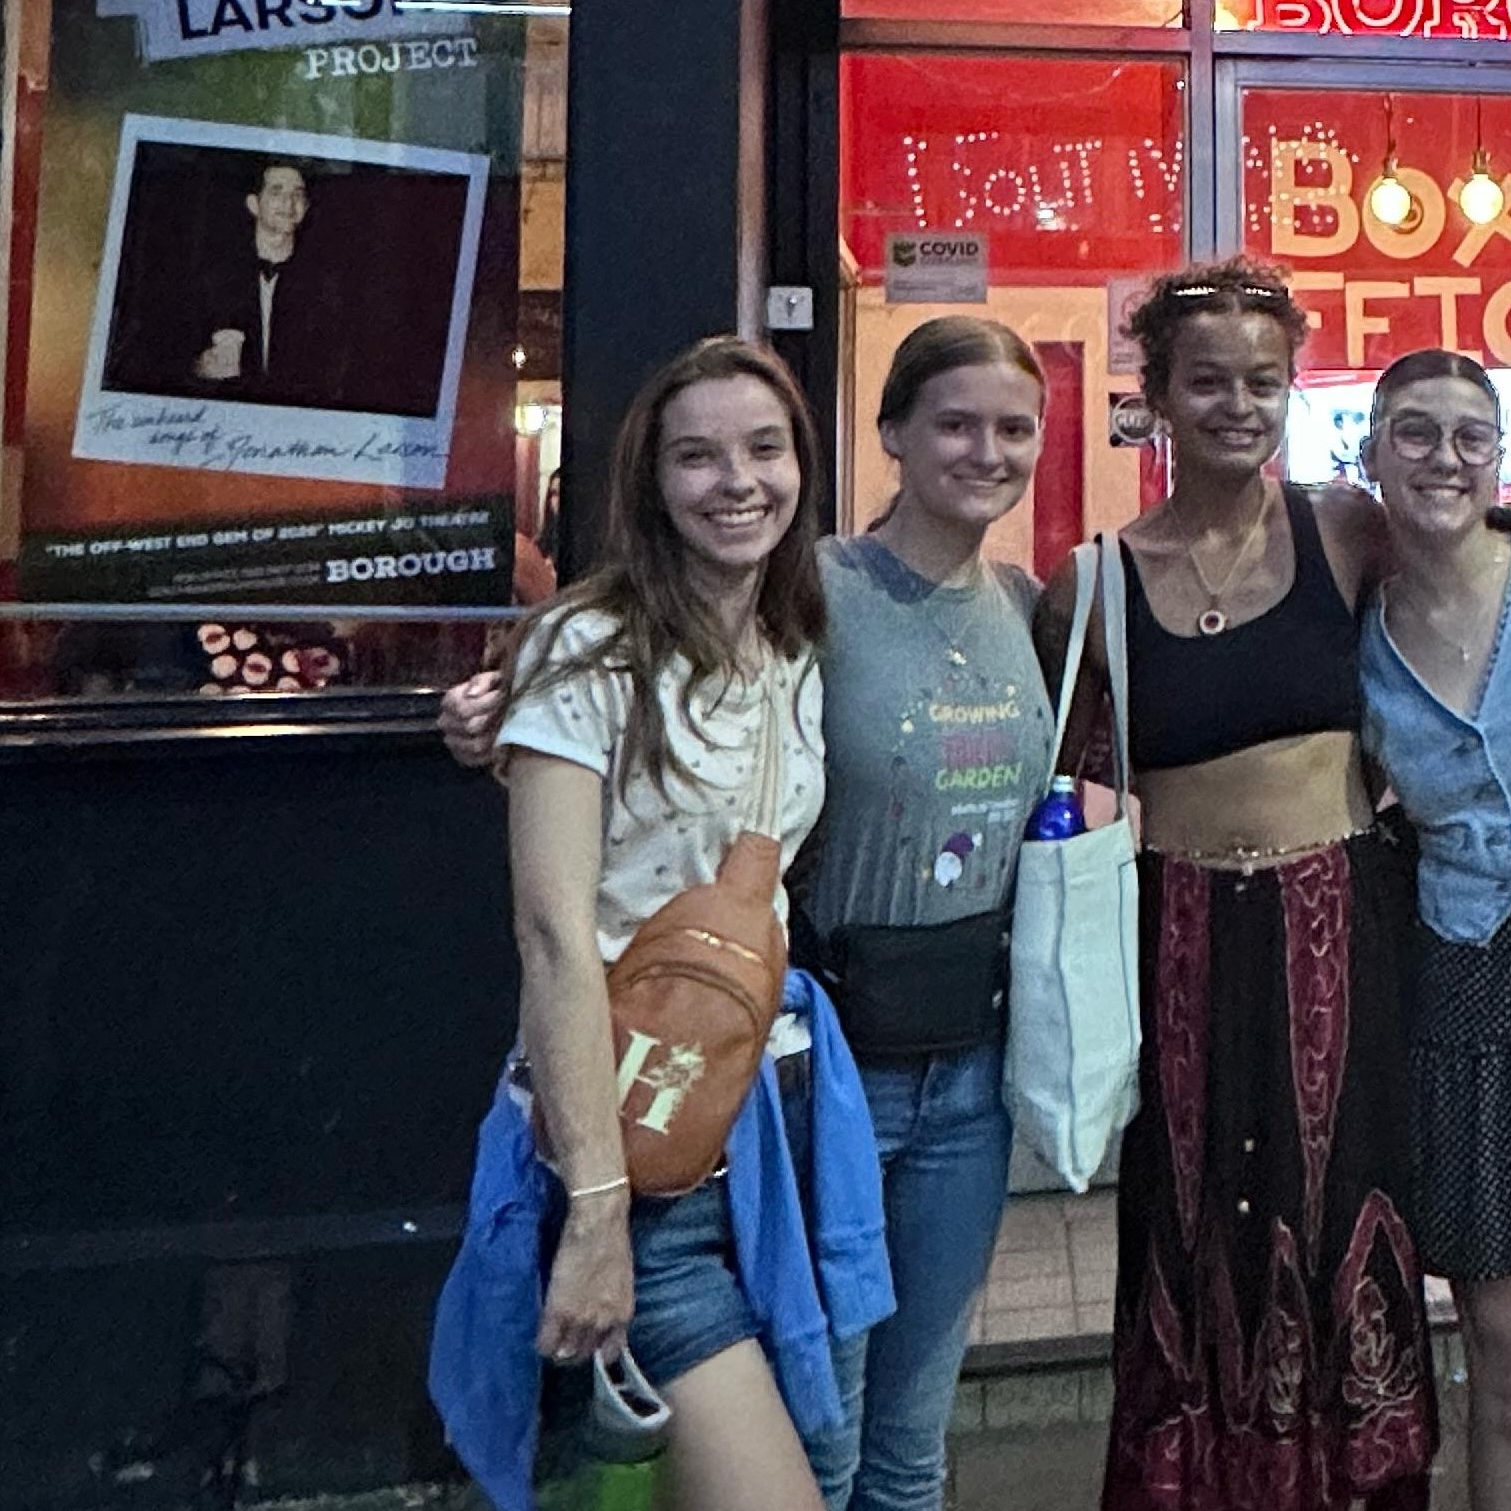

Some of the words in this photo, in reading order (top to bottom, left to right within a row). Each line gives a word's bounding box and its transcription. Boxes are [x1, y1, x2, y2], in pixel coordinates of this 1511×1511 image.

[303, 38, 478, 80] PROJECT
[919, 241, 979, 257] COVID
[325, 546, 497, 584] BOROUGH
[928, 700, 1021, 725] GROWING
[934, 762, 1022, 791] GARDEN
